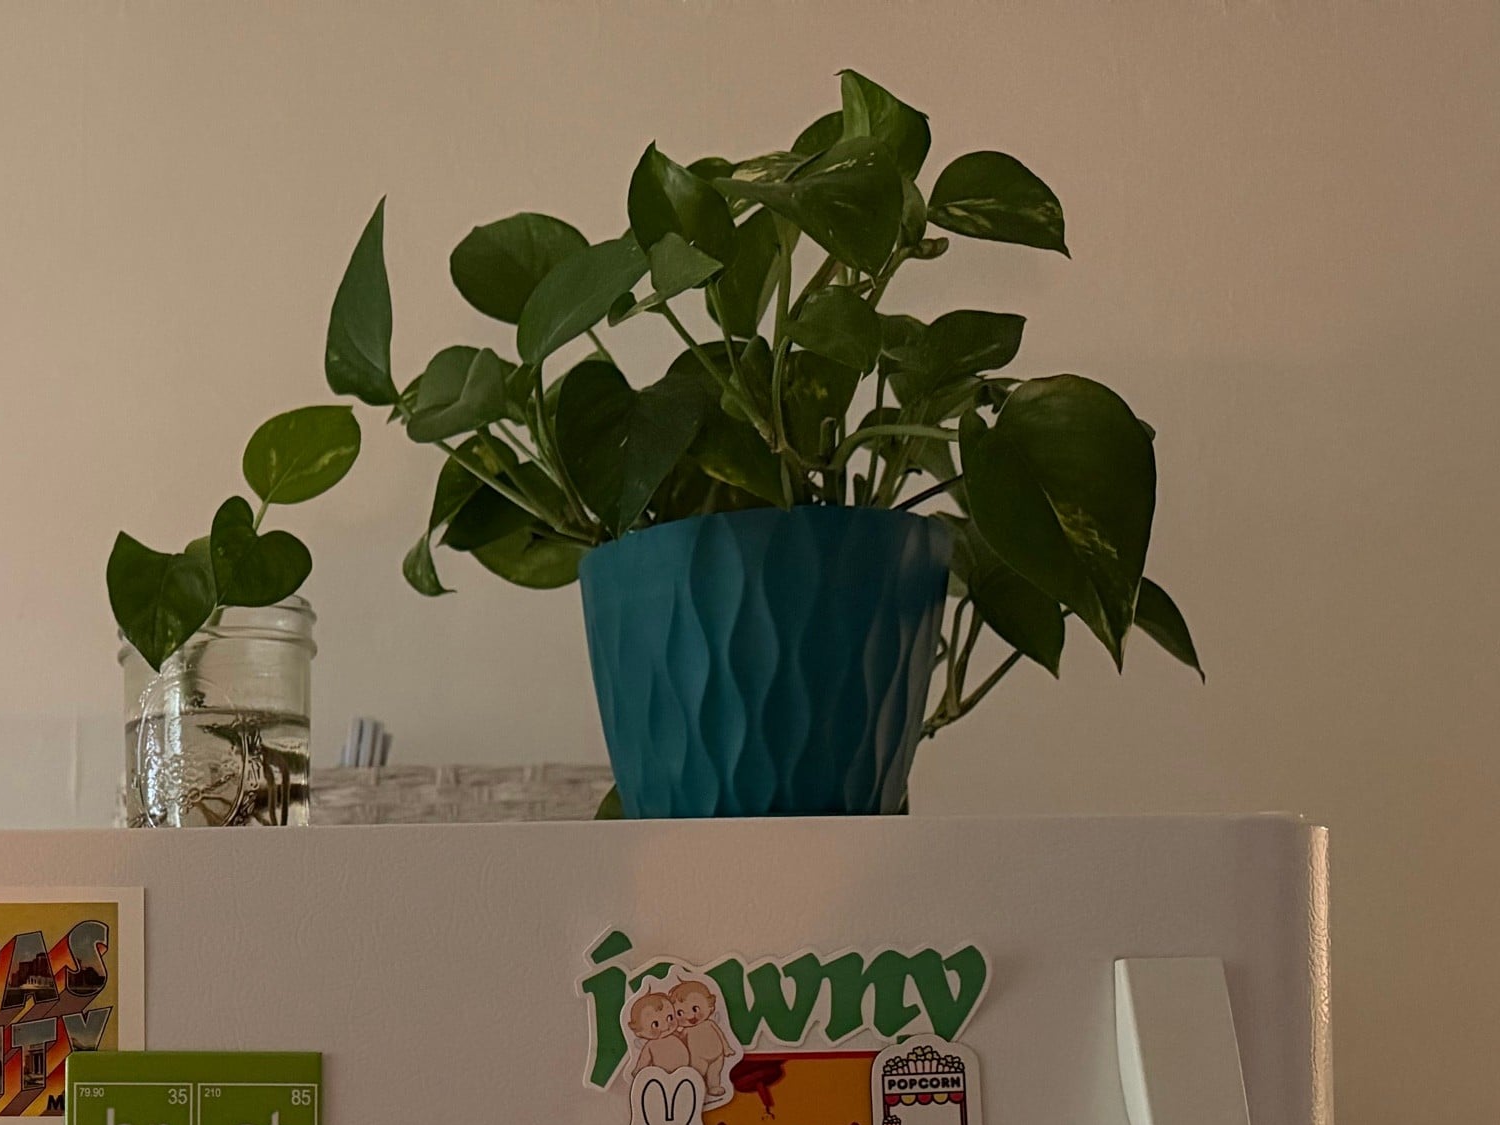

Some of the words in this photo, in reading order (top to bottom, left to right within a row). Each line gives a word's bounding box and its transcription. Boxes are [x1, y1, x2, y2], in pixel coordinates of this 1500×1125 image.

[887, 1076, 961, 1090] POPCORN
[79, 1087, 105, 1098] 79.90
[168, 1089, 188, 1105] 35
[204, 1088, 221, 1098] 210
[291, 1089, 311, 1106] 85
